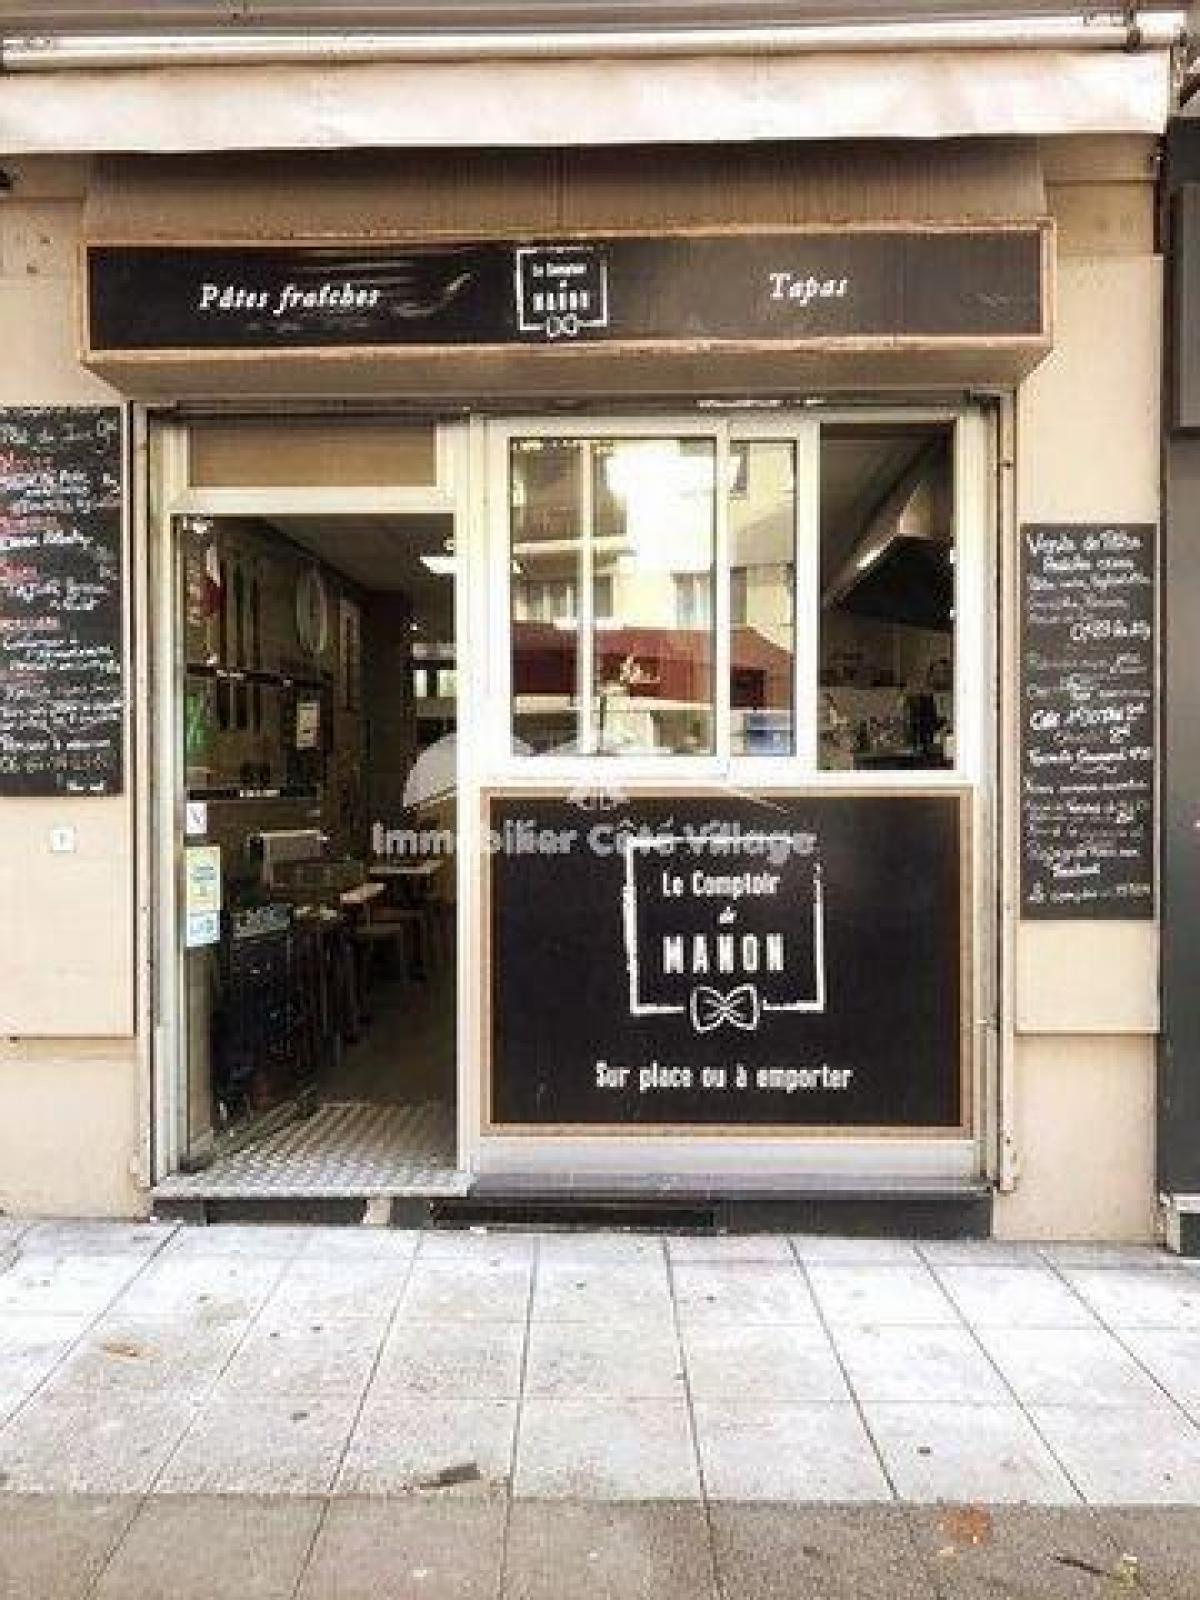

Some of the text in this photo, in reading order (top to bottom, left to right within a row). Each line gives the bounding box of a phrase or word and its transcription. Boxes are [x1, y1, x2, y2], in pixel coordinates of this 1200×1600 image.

[768, 271, 848, 308] Tapas
[661, 869, 781, 901] Le Comptoir
[661, 932, 786, 974] MANON
[595, 1060, 854, 1095] Sur place ou à emporter
